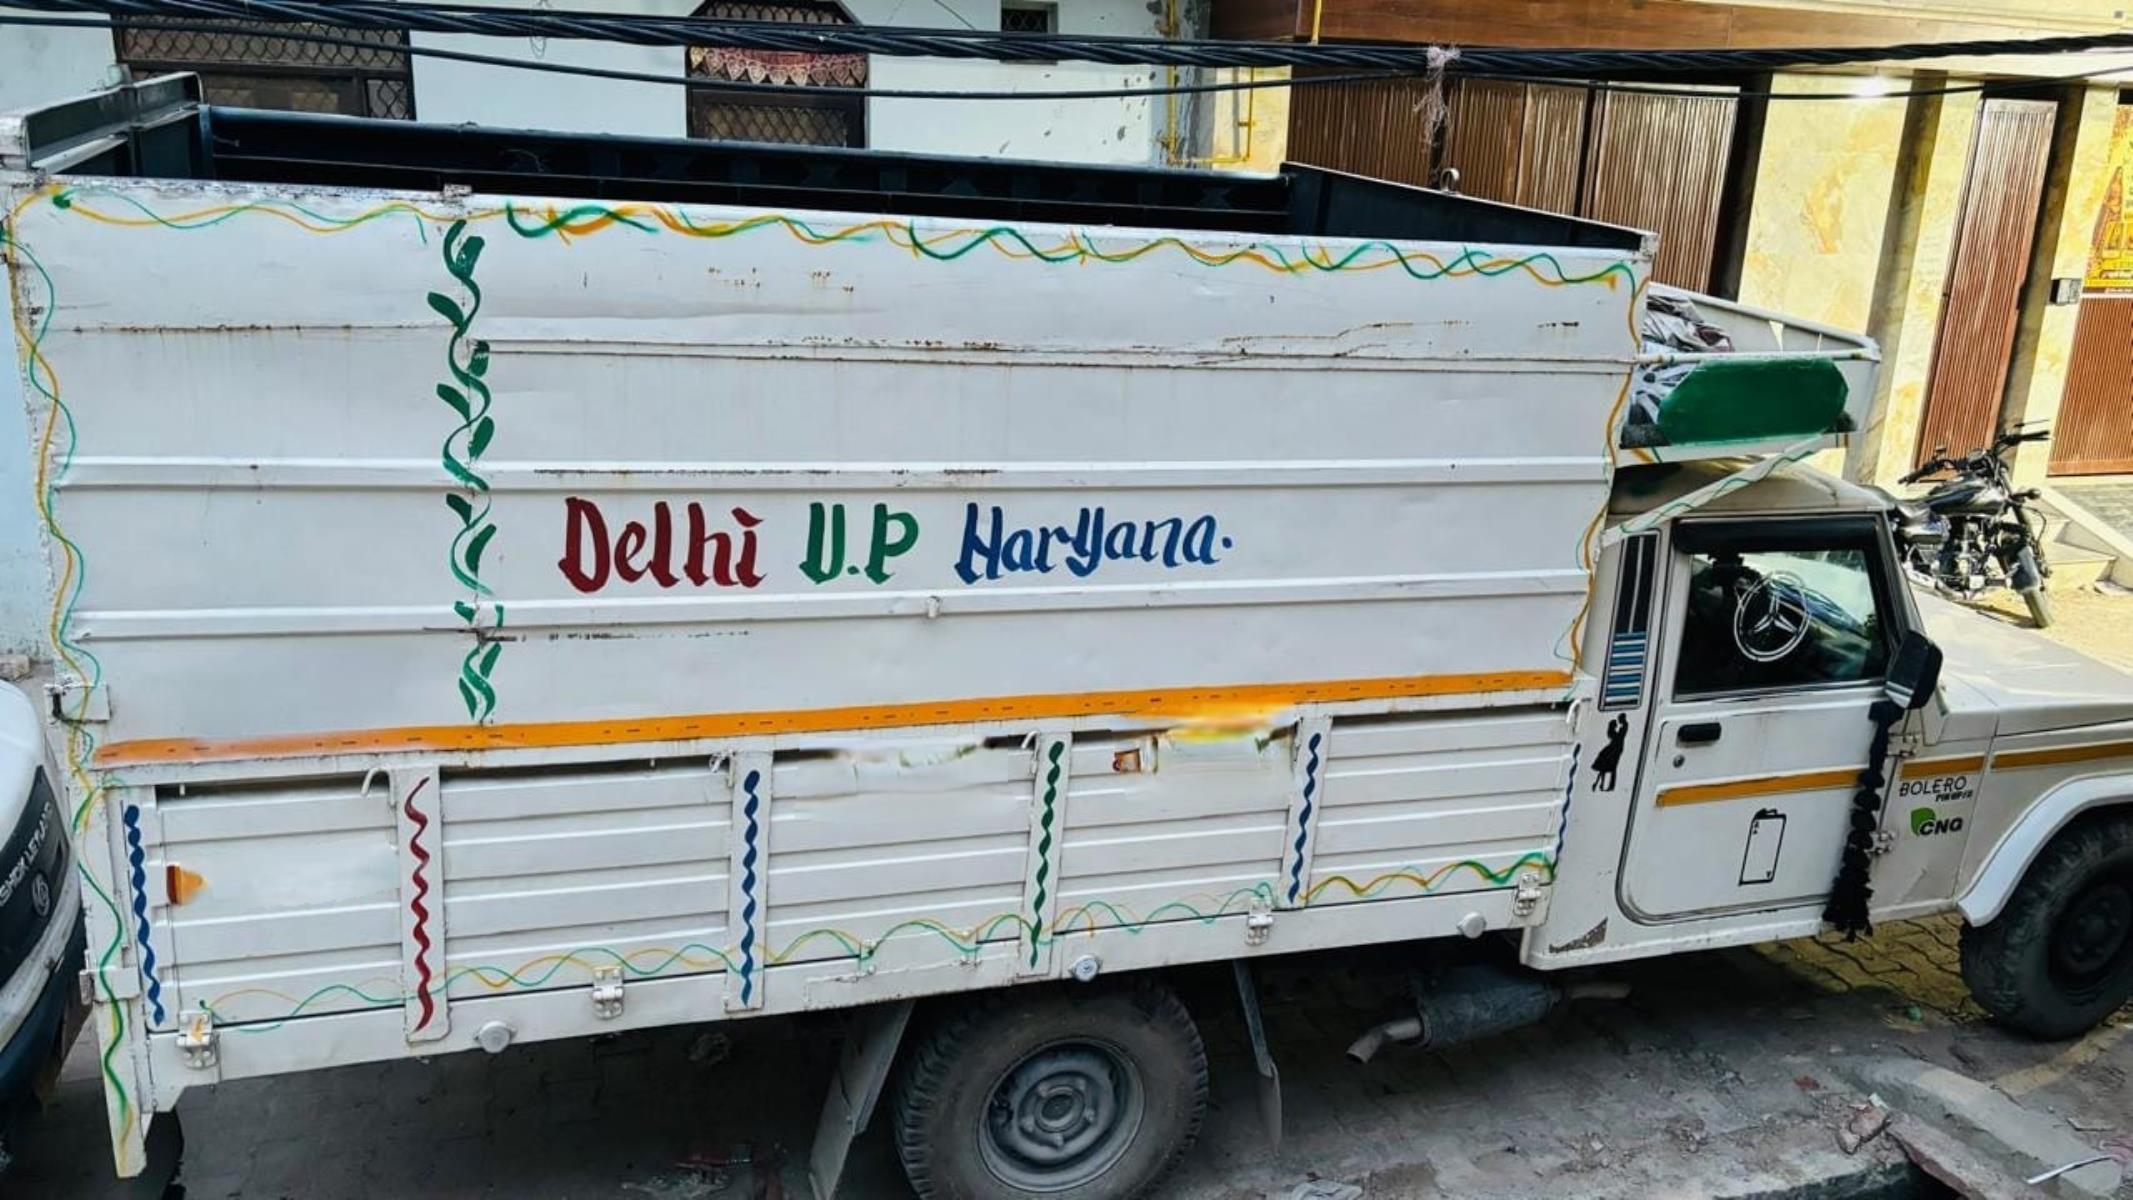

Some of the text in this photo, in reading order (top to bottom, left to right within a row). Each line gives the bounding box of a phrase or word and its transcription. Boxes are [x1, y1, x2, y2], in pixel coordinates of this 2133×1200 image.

[558, 496, 767, 593] Delhi
[799, 502, 920, 585] U.P
[1900, 776, 1967, 797] BOLERO
